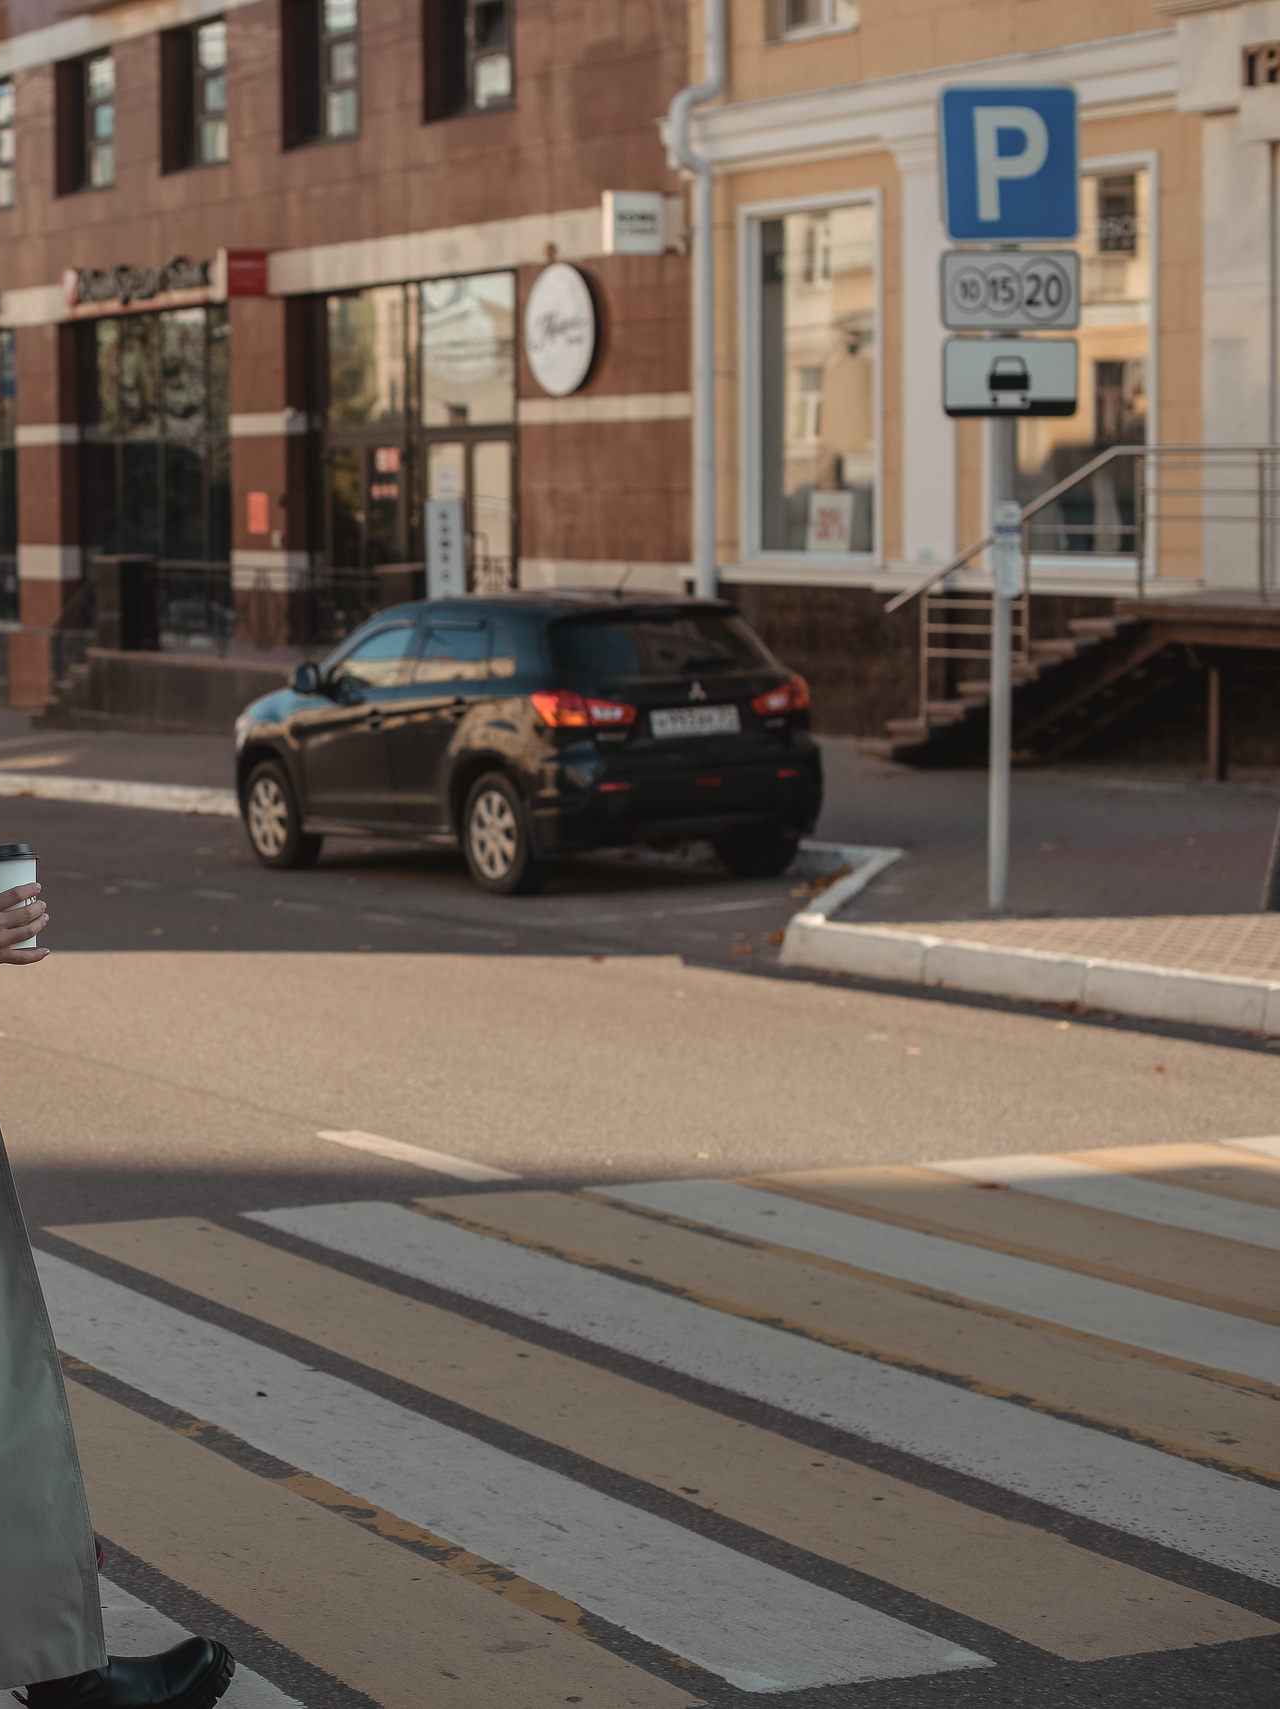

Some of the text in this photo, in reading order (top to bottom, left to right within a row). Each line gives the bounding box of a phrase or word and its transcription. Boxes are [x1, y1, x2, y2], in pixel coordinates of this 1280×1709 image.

[973, 106, 1049, 222] P
[959, 272, 1063, 308] 10 15 20
